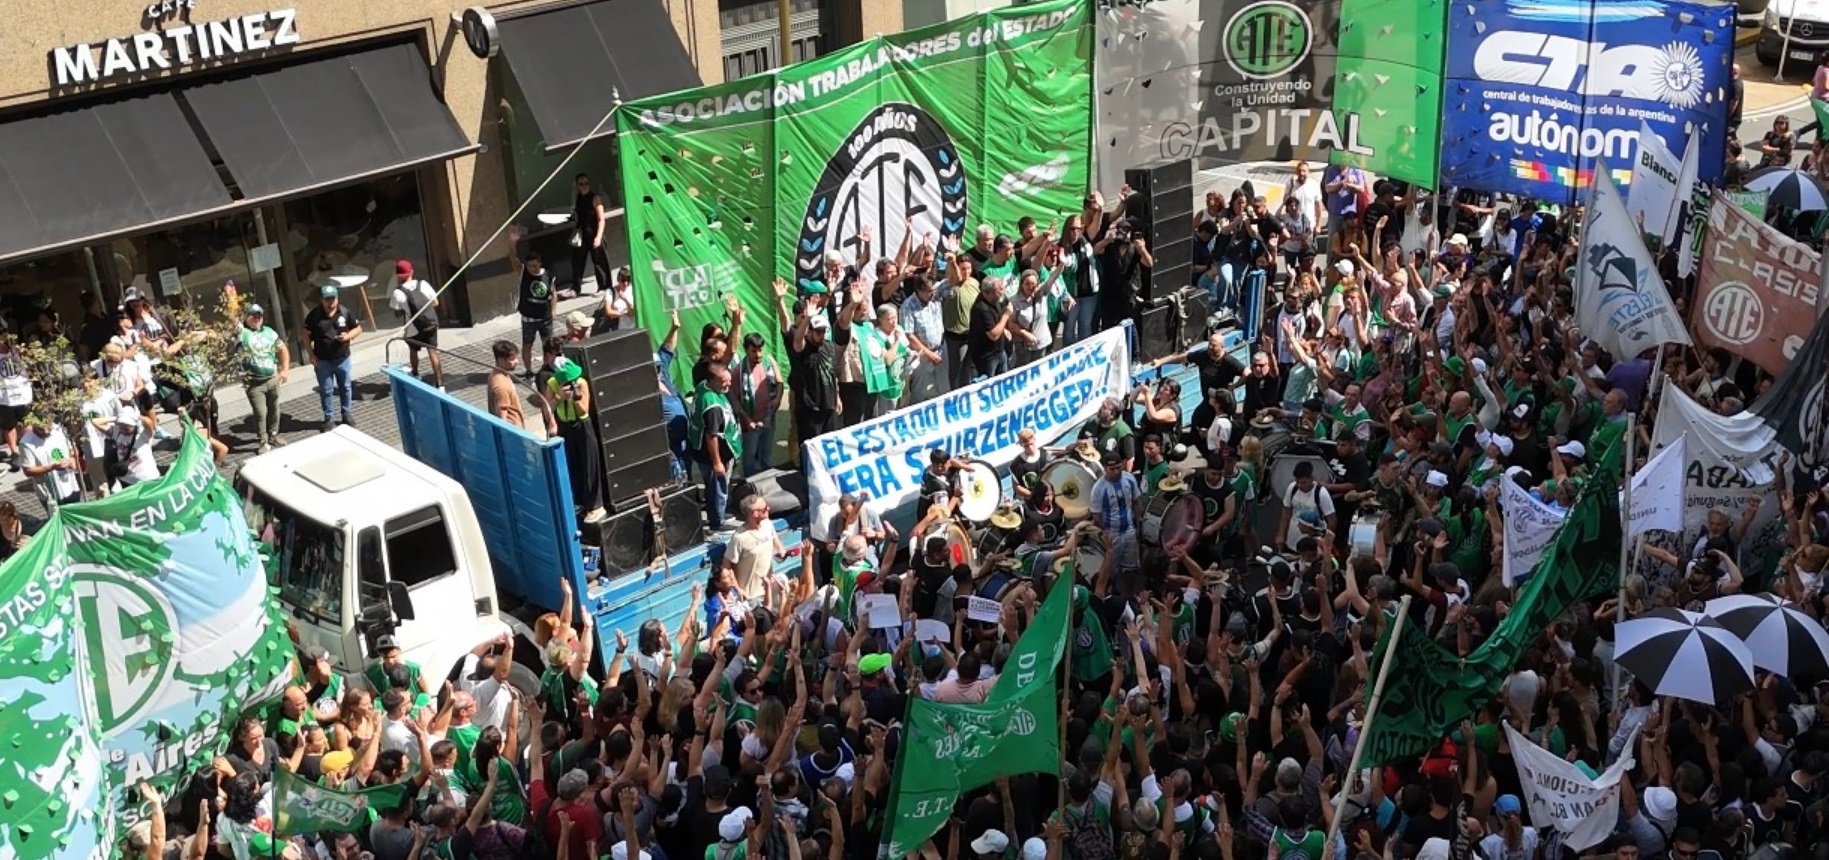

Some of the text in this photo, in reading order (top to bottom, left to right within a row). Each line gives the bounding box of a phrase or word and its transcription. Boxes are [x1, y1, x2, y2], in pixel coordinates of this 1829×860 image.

[53, 8, 300, 85] MARTINEZ
[1235, 9, 1303, 67] ATE
[640, 80, 805, 128] ASOCIACIÓN
[808, 31, 961, 98] TRABAJADORES
[967, 22, 997, 47] del
[1214, 78, 1313, 97] Construyendo
[1474, 29, 1665, 102] CTA
[1231, 91, 1296, 108] la Unidad
[1482, 90, 1517, 102] central
[1518, 90, 1531, 103] de
[1600, 103, 1613, 116] de
[1615, 103, 1626, 116] la
[1628, 107, 1676, 124] argentina
[1160, 107, 1376, 158] CAPITAL
[1488, 109, 1666, 160] autónom
[1709, 286, 1759, 341] ATE
[821, 434, 853, 469] EL
[857, 406, 940, 455] ESTADO
[944, 391, 971, 423] NO
[836, 454, 903, 501] ERA
[130, 502, 168, 532] EN
[168, 484, 195, 513] LA
[1016, 652, 1037, 689] DE
[124, 718, 220, 788] Aires
